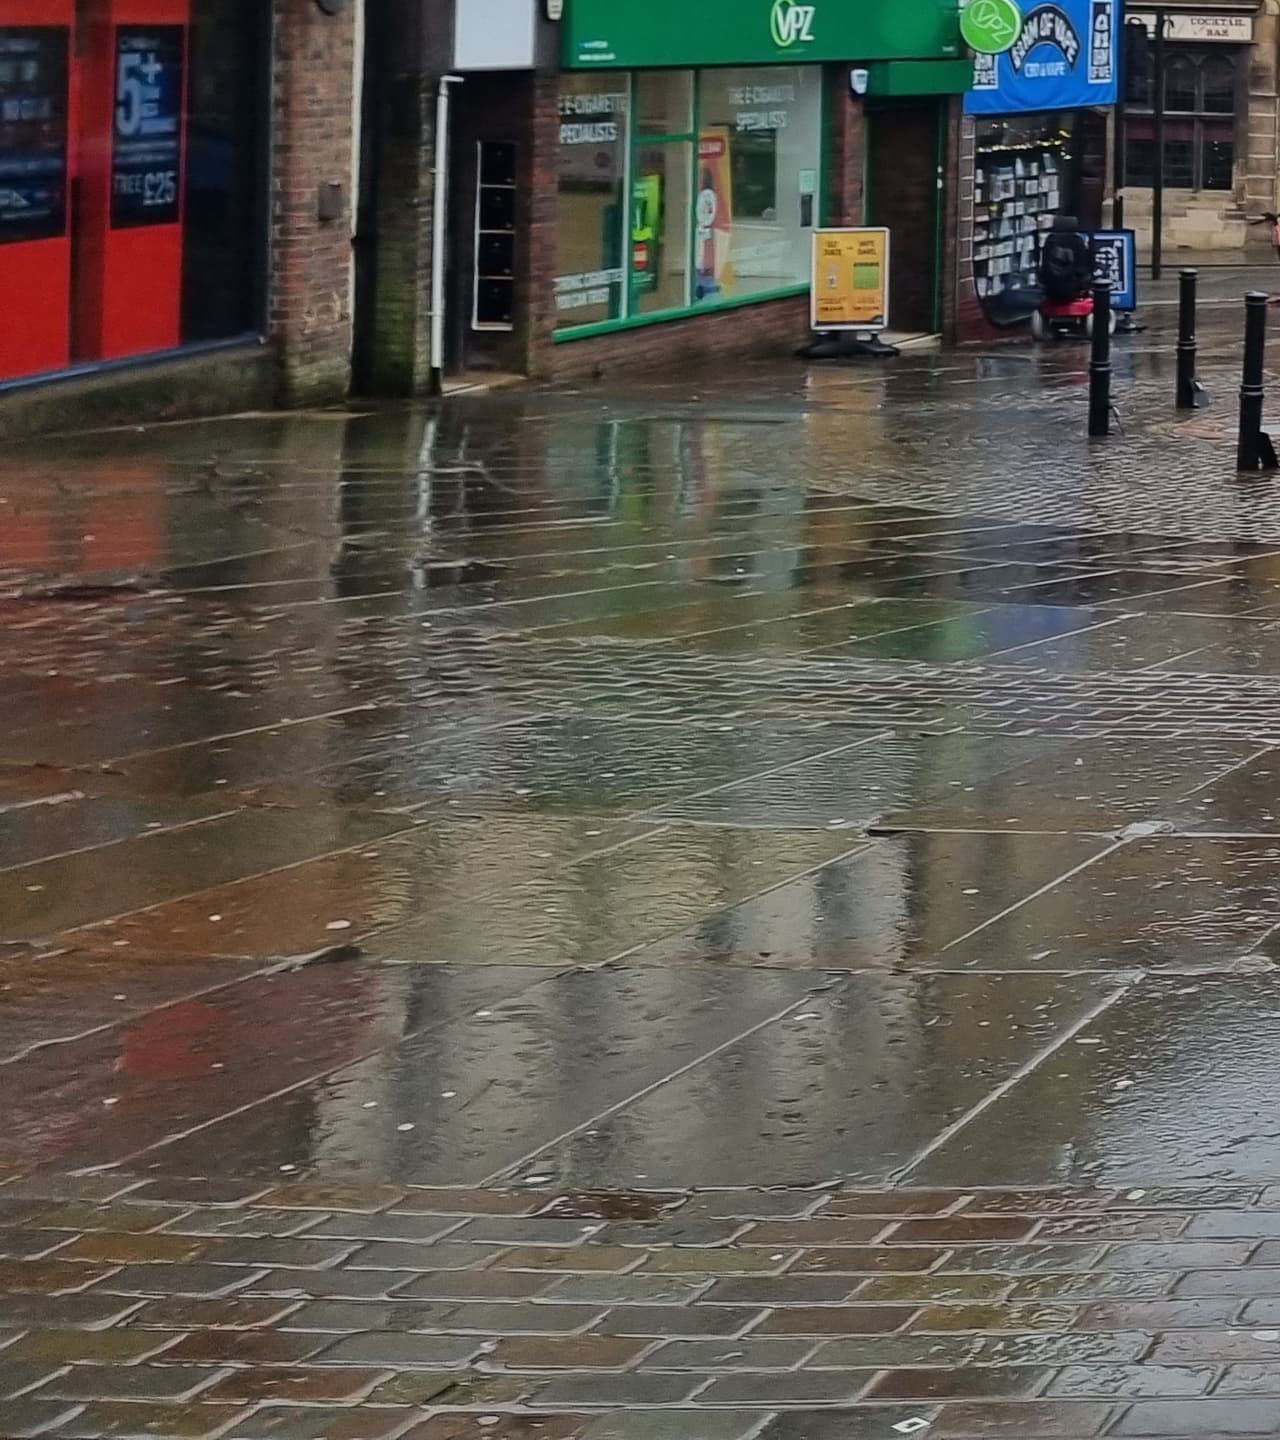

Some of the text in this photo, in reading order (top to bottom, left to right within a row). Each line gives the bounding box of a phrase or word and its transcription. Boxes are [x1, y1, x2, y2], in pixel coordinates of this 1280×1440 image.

[773, 3, 815, 42] VPZ
[972, 2, 1014, 43] VPZ
[1191, 18, 1245, 27] COCKTAIL
[1206, 29, 1229, 37] BAR
[143, 171, 176, 206] £25
